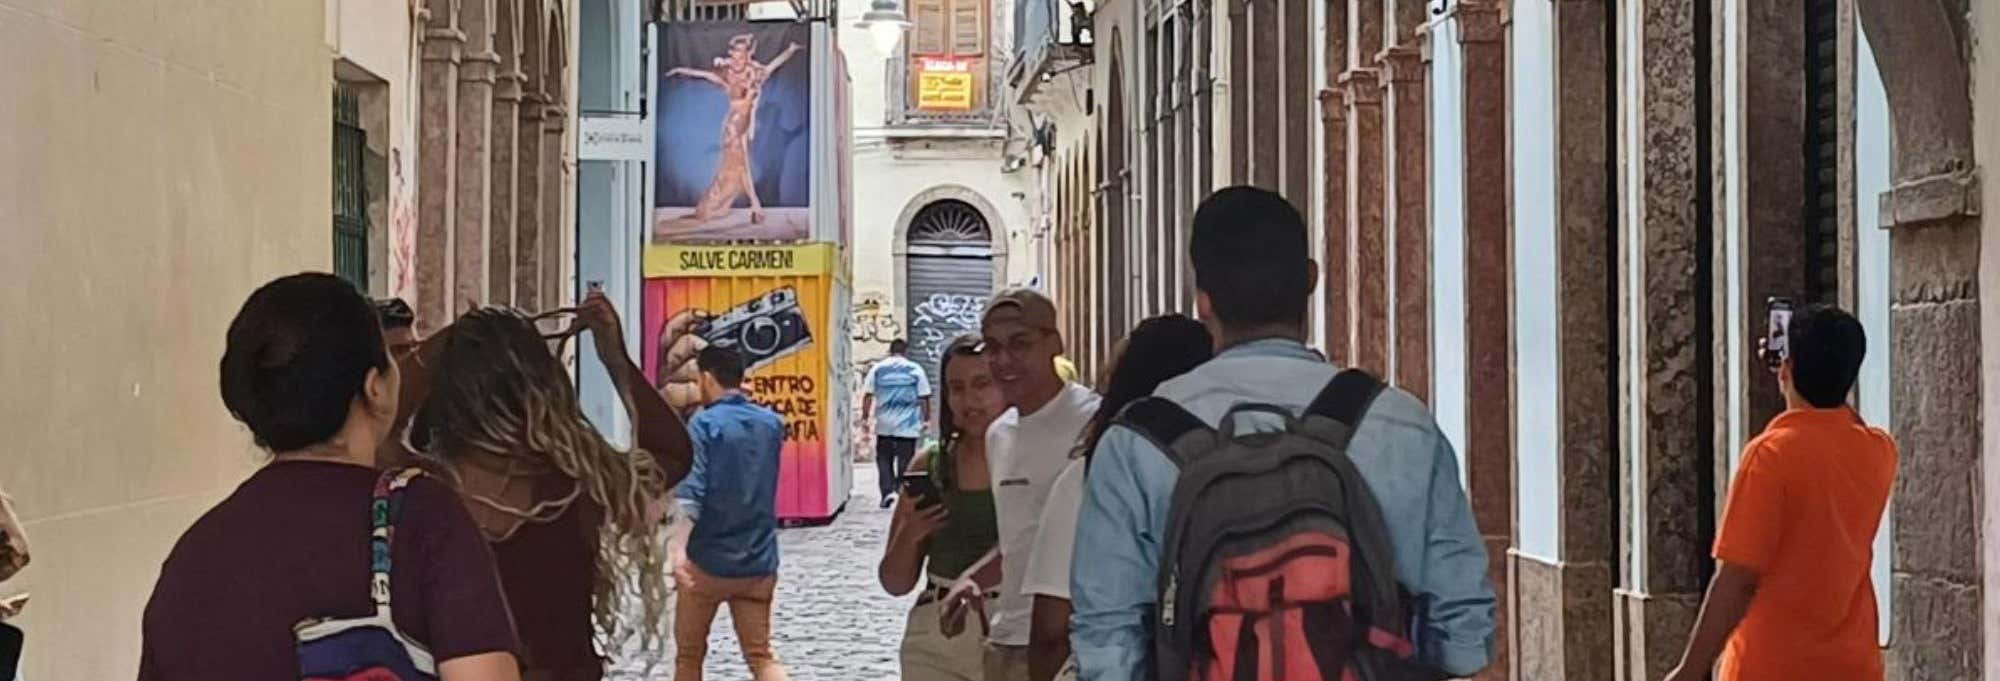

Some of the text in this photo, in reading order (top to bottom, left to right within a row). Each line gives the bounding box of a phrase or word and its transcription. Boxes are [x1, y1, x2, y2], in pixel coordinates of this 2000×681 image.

[679, 249, 794, 270] SALVE CARMEN!
[797, 397, 817, 416] DE
[783, 420, 819, 441] AFIA
